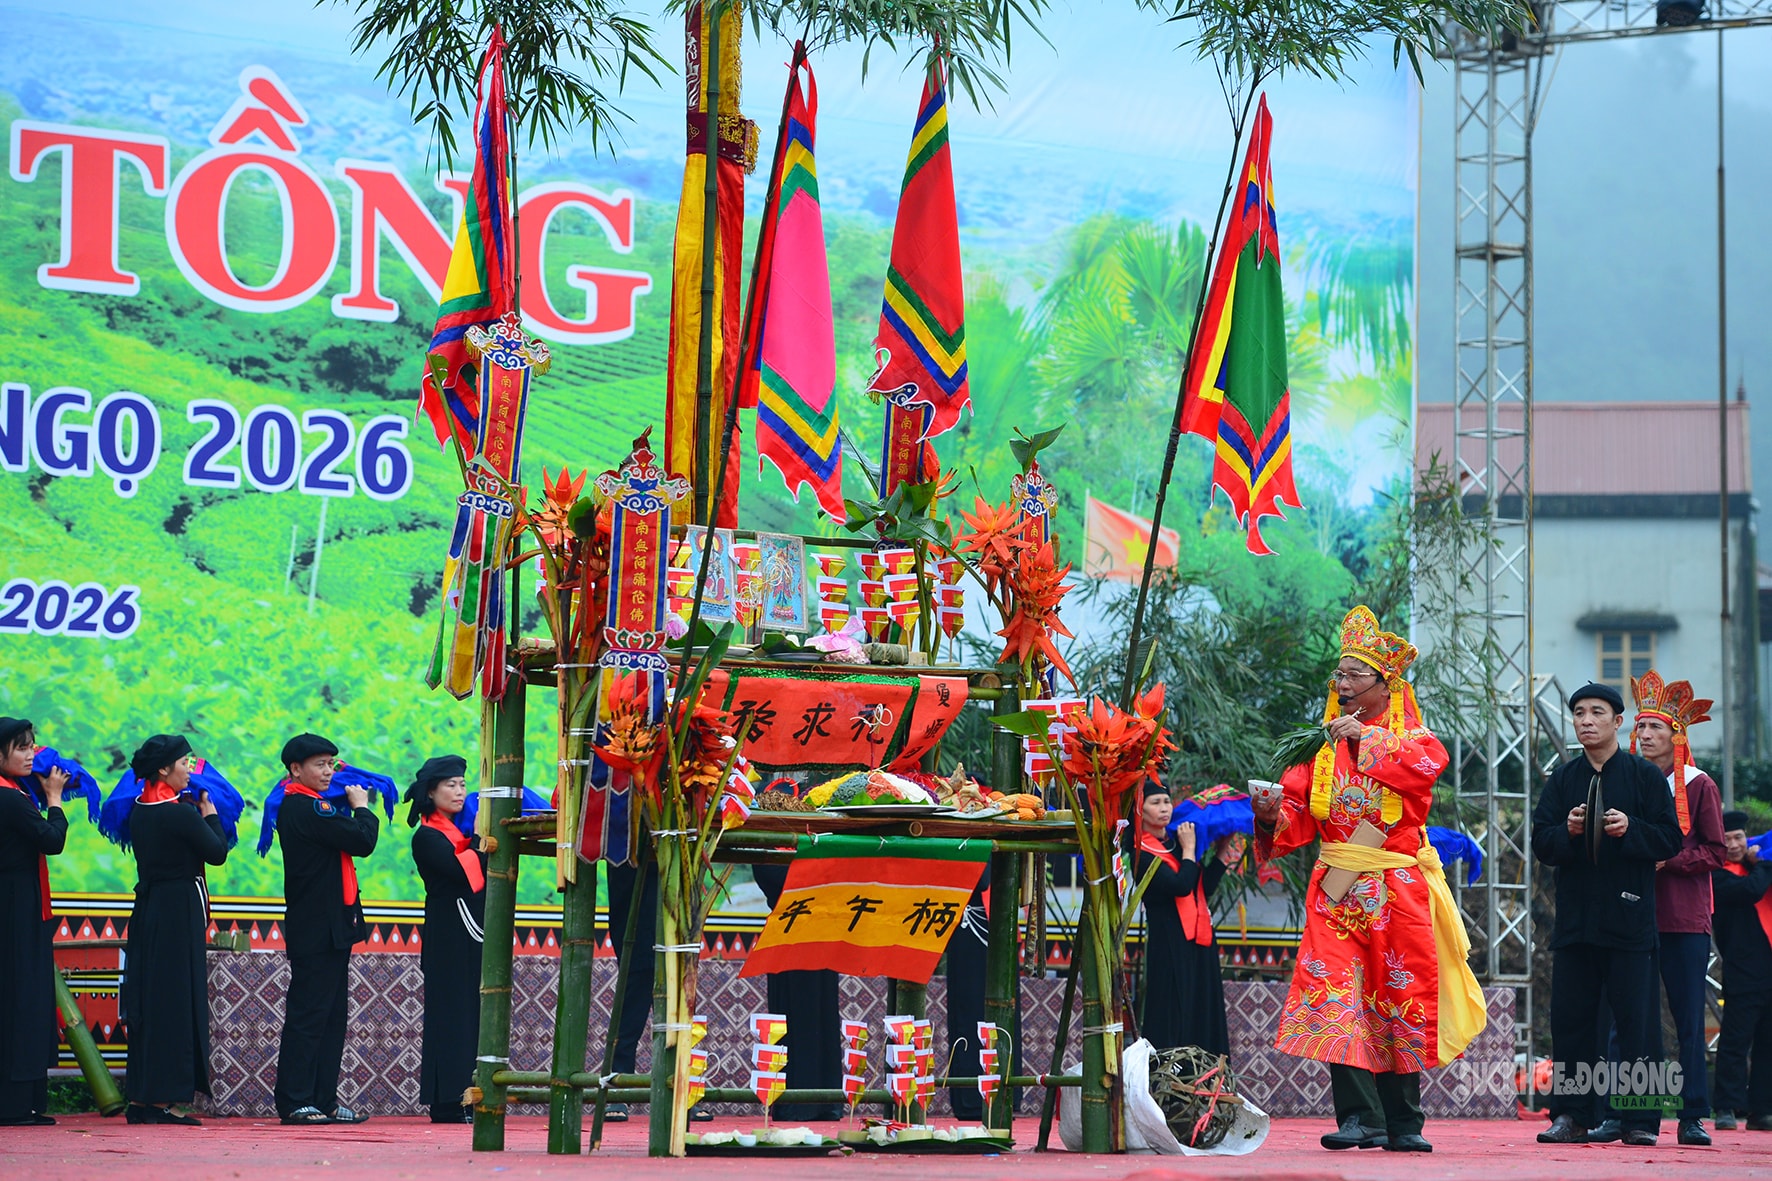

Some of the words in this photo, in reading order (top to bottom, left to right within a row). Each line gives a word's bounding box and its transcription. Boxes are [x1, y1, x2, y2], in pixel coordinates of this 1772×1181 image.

[16, 74, 653, 338] TỒNG
[187, 404, 410, 495] 2026
[0, 583, 137, 634] 2026
